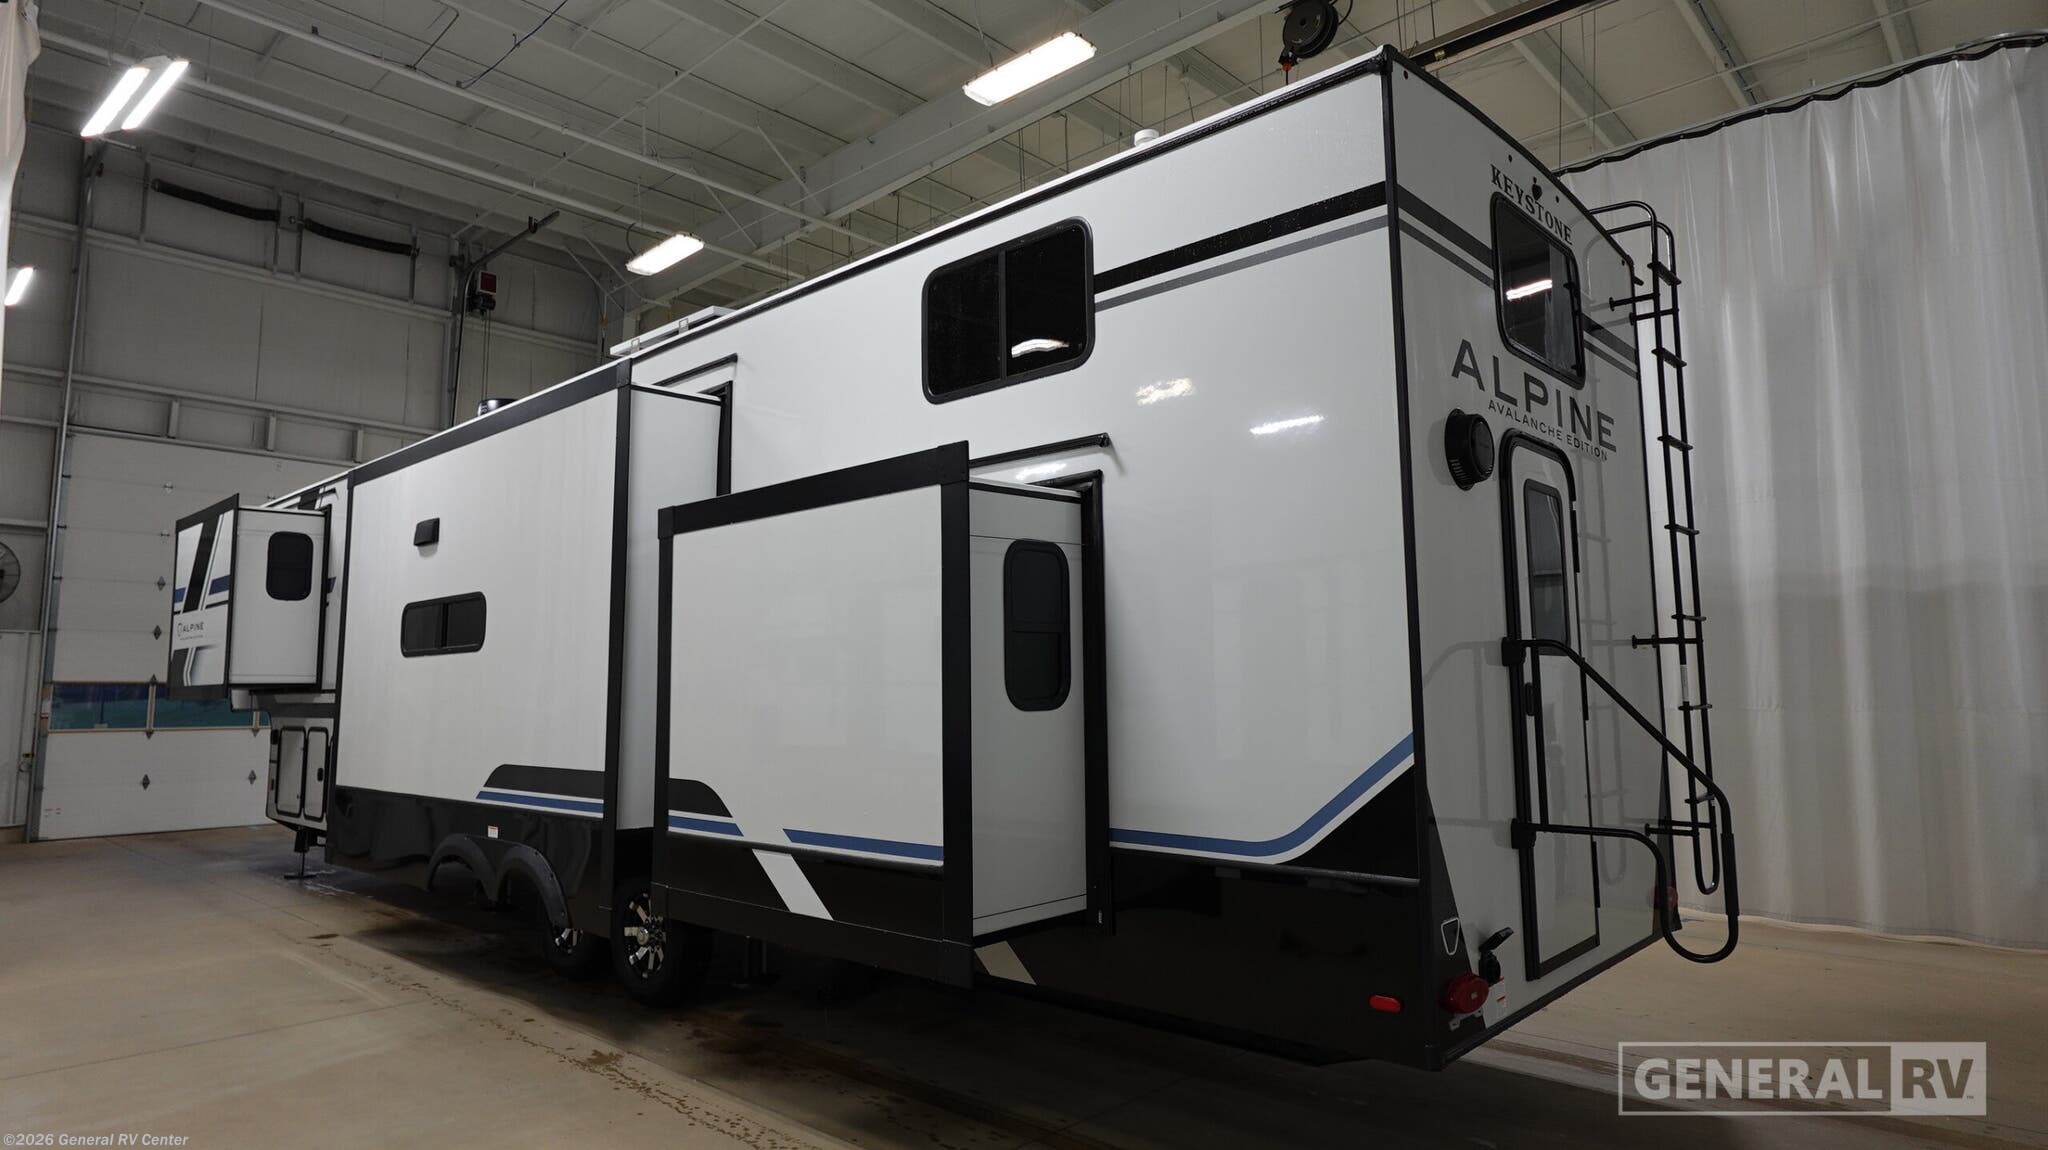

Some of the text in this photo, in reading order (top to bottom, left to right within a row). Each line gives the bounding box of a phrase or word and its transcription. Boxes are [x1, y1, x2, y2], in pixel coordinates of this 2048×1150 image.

[1490, 163, 1573, 246] KEYSTONE
[1450, 338, 1617, 452] ALPINE
[1488, 399, 1608, 461] AVALANCHE EDITION
[183, 621, 204, 632] ALPINE
